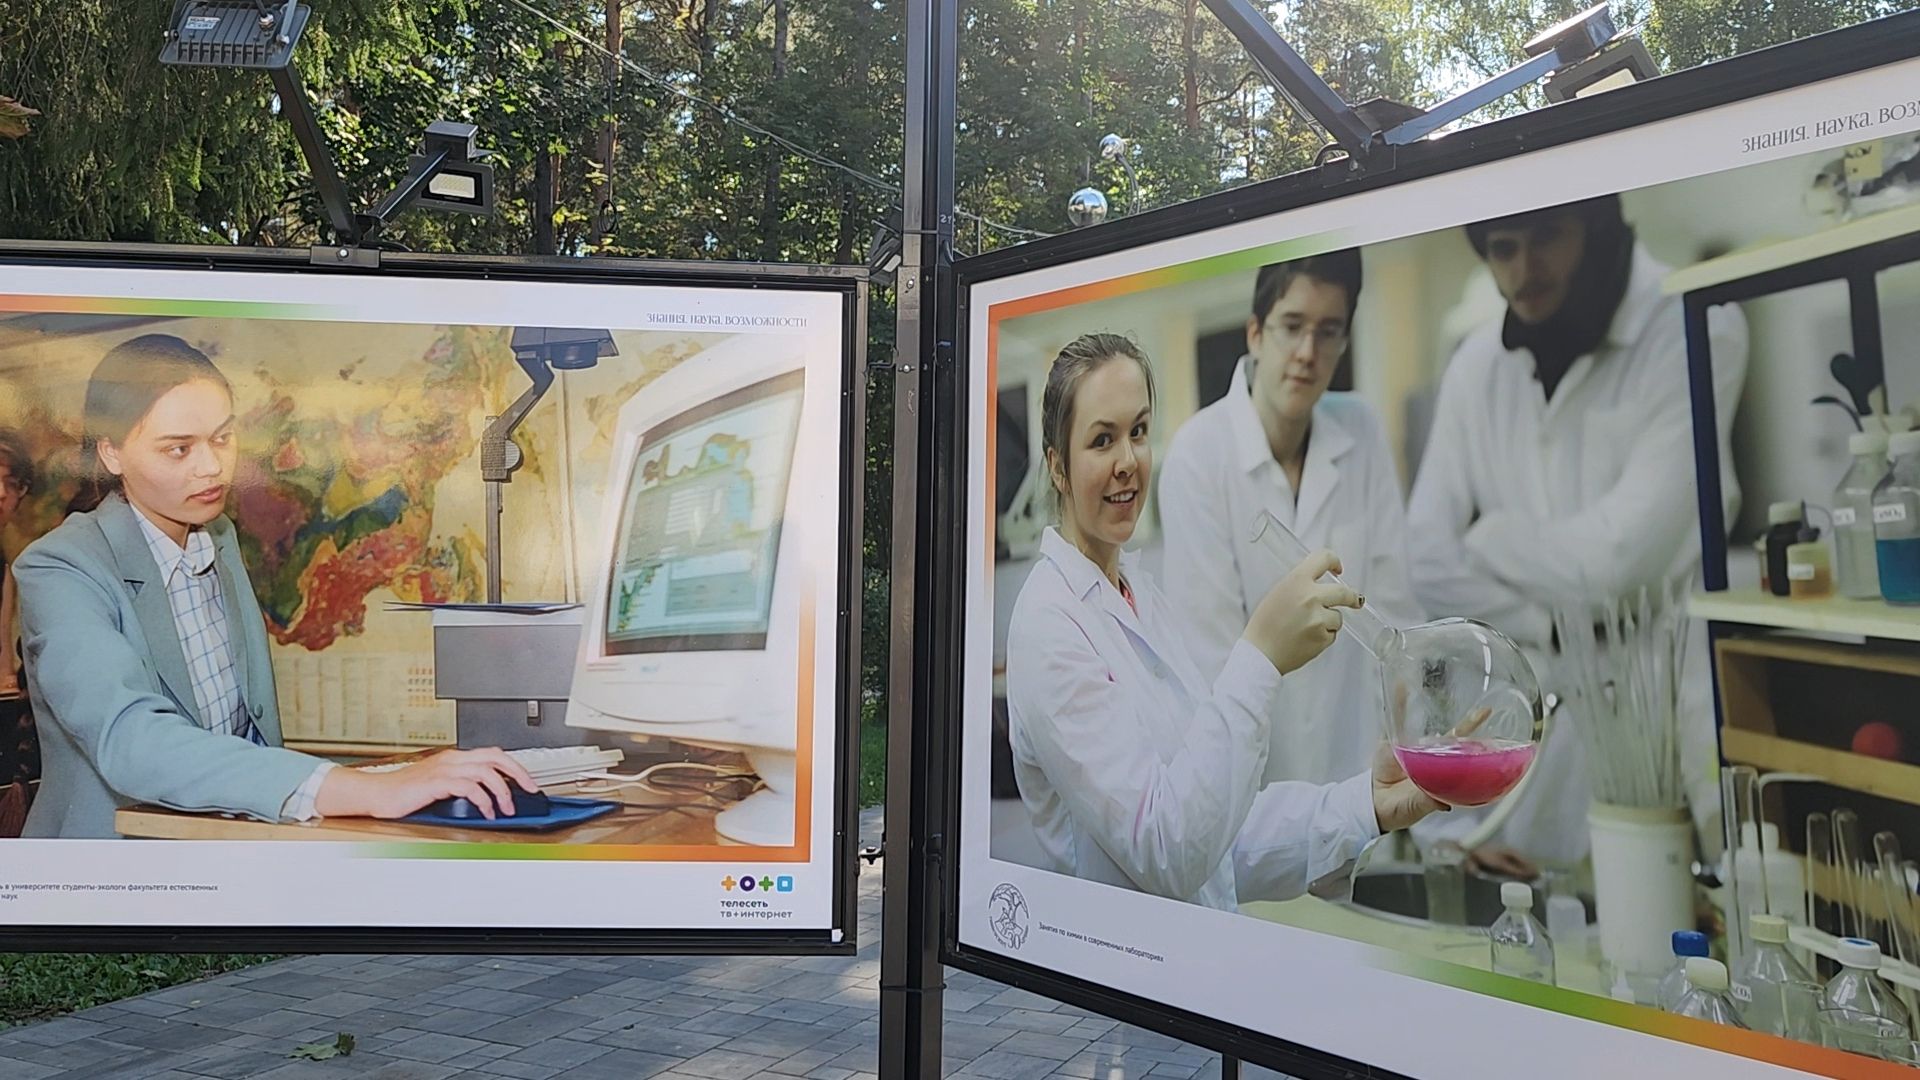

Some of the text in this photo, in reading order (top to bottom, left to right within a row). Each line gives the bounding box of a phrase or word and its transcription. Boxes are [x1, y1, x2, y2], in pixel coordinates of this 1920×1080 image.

[1815, 111, 1874, 138] наука.
[1879, 100, 1920, 124] воз
[725, 315, 807, 328] возможности
[128, 884, 168, 892] факультета
[720, 900, 769, 908] телесеть
